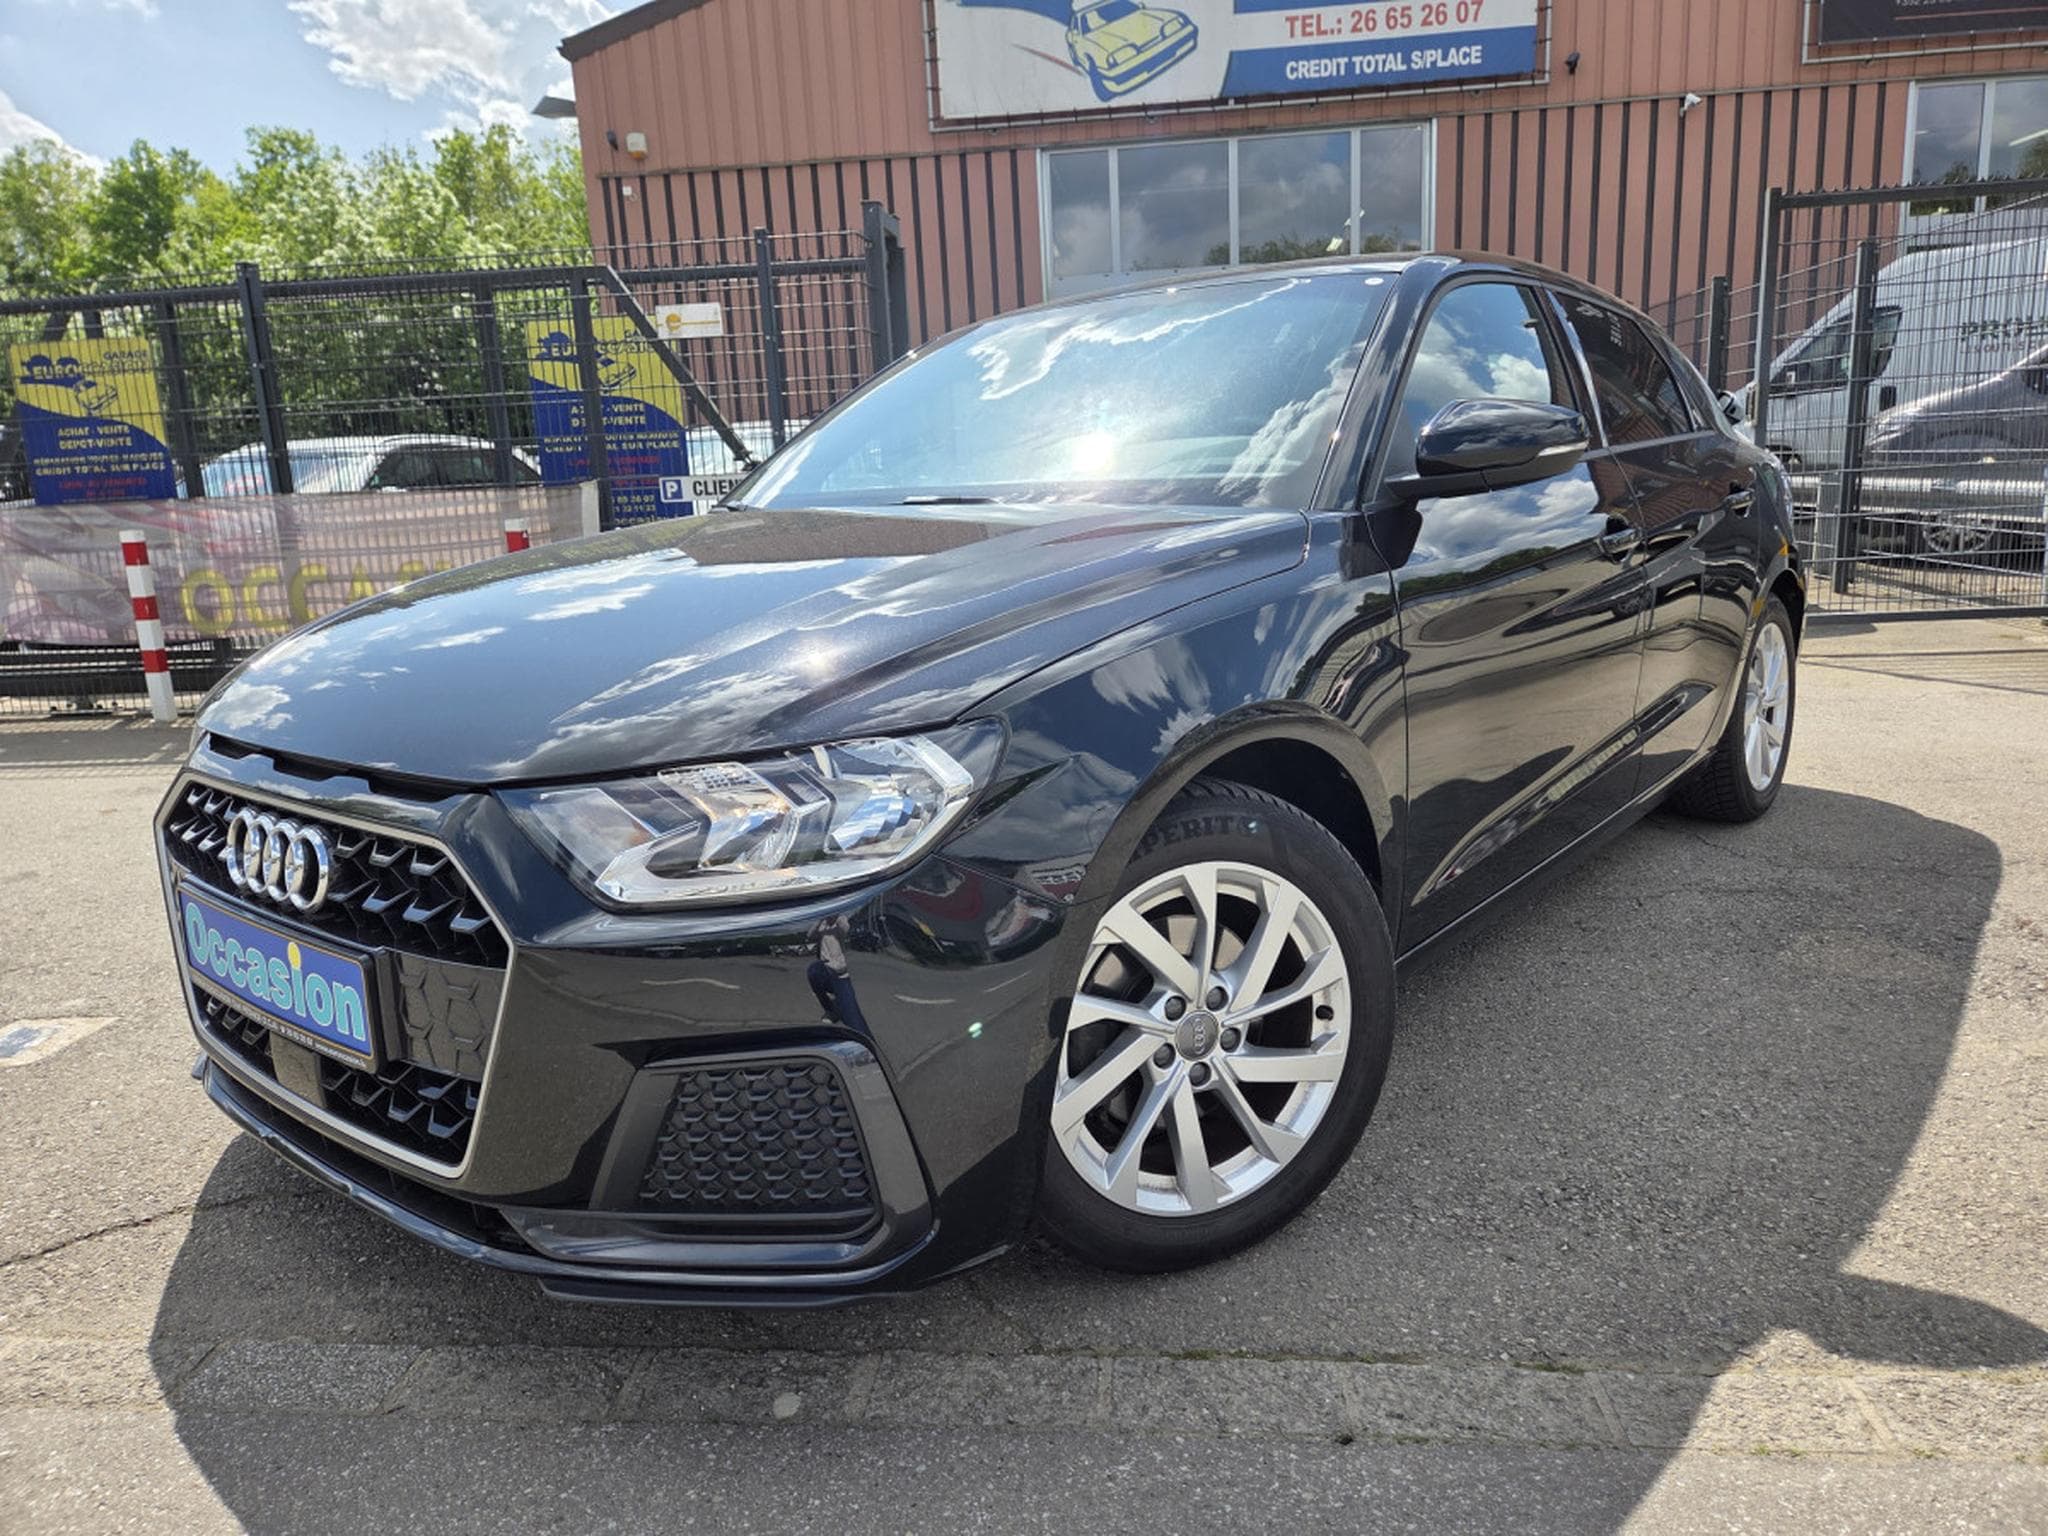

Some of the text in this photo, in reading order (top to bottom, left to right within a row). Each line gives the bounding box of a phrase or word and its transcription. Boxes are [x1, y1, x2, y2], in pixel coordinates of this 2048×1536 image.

[1285, 0, 1484, 38] TEL.: 26 65 26 07
[1286, 45, 1482, 80] CREDIT TOTAL S/PLACE
[692, 479, 741, 497] CLIEN
[185, 902, 366, 1042] Occasion
